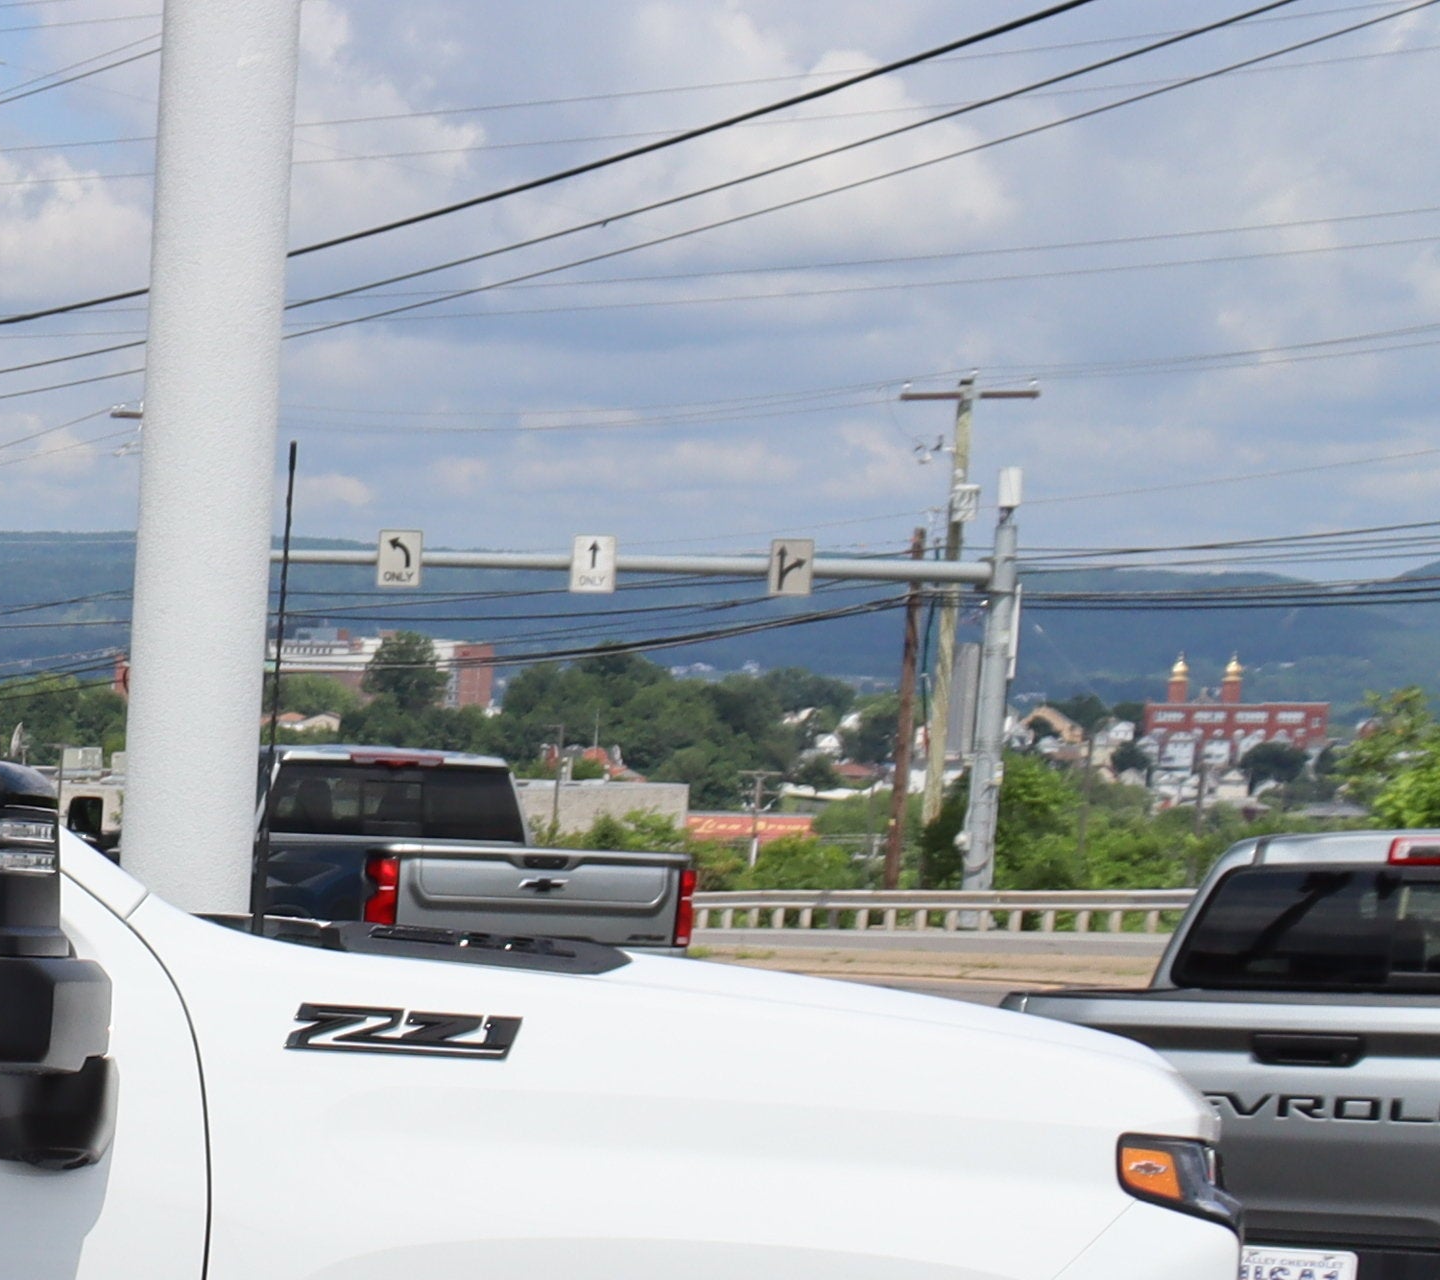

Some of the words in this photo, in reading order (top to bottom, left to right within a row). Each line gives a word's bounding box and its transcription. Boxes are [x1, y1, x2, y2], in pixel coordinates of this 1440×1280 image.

[383, 571, 414, 582] ONLY
[579, 574, 606, 587] ONLY
[283, 1002, 524, 1061] Z71
[1280, 1258, 1345, 1269] CHEVROLET
